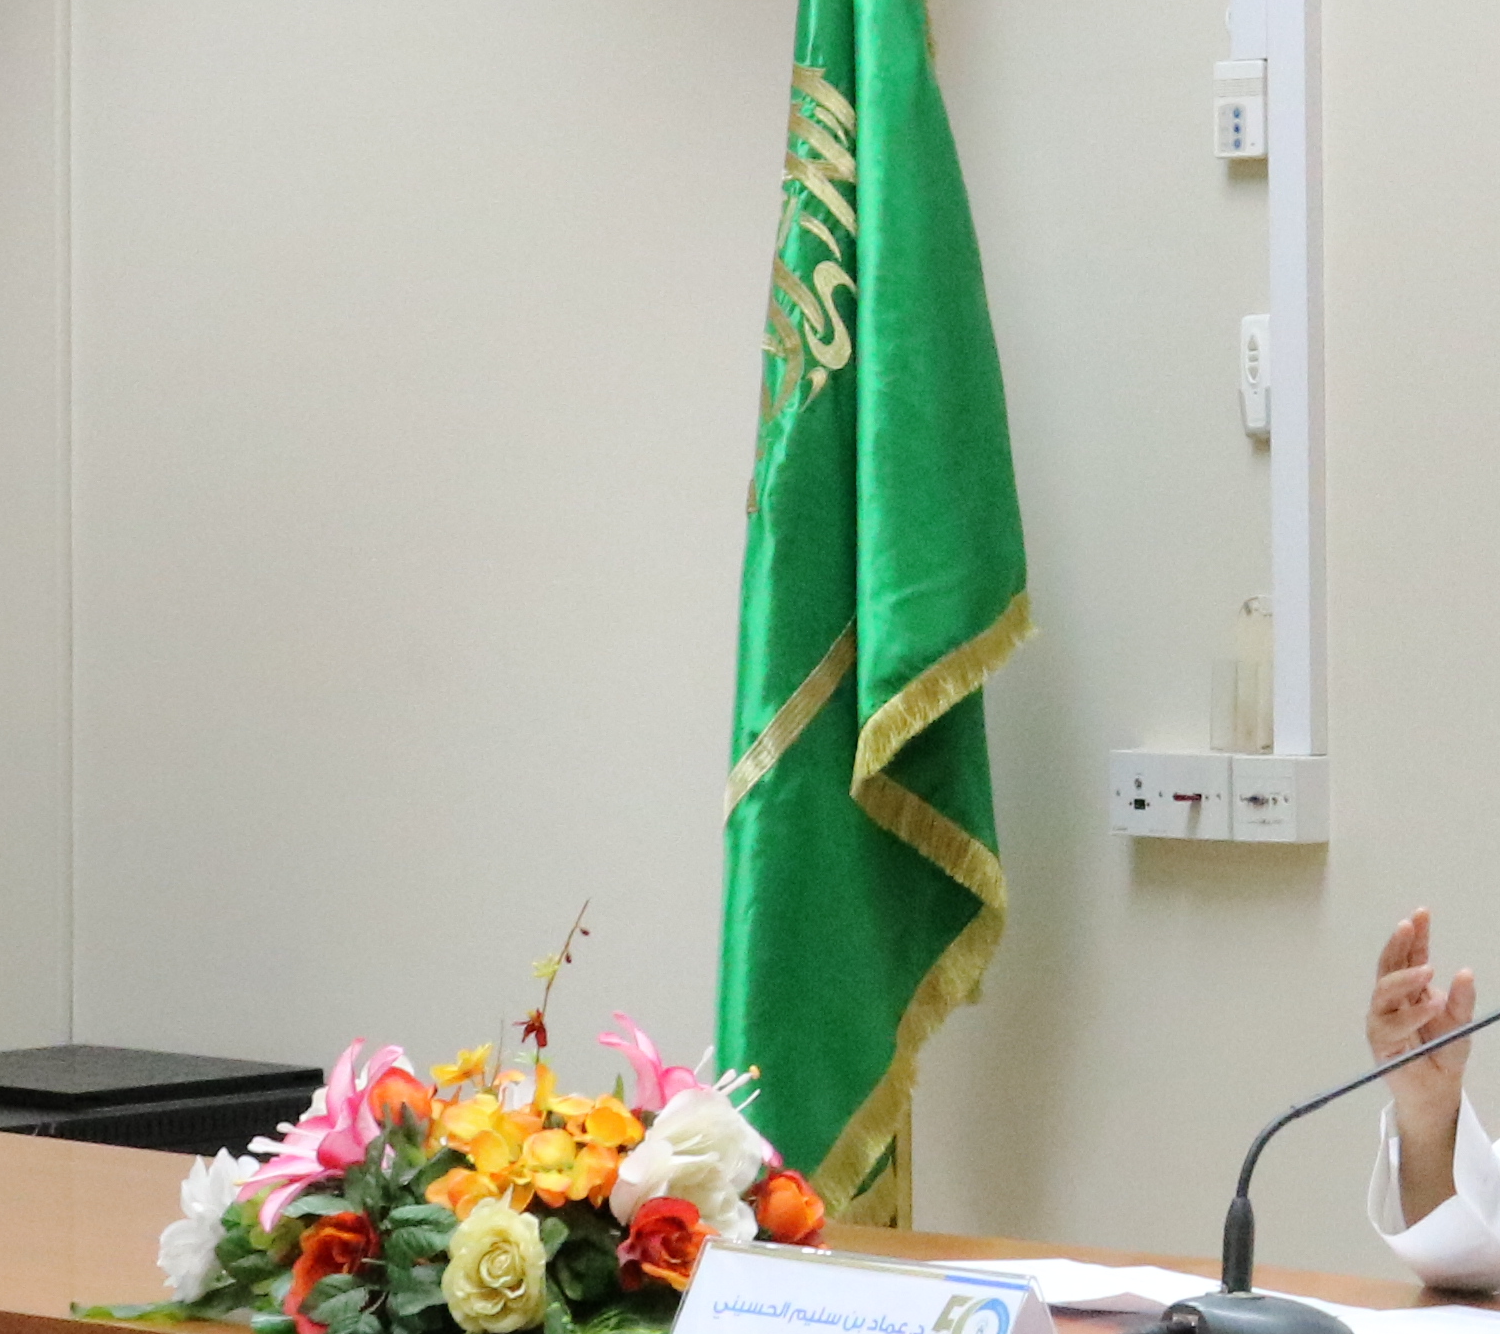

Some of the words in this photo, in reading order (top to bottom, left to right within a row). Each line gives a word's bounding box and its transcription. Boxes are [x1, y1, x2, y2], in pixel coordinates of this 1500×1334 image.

[713, 1295, 790, 1320] الحسيني
[790, 1303, 843, 1326] سليم
[843, 1310, 867, 1332] بن
